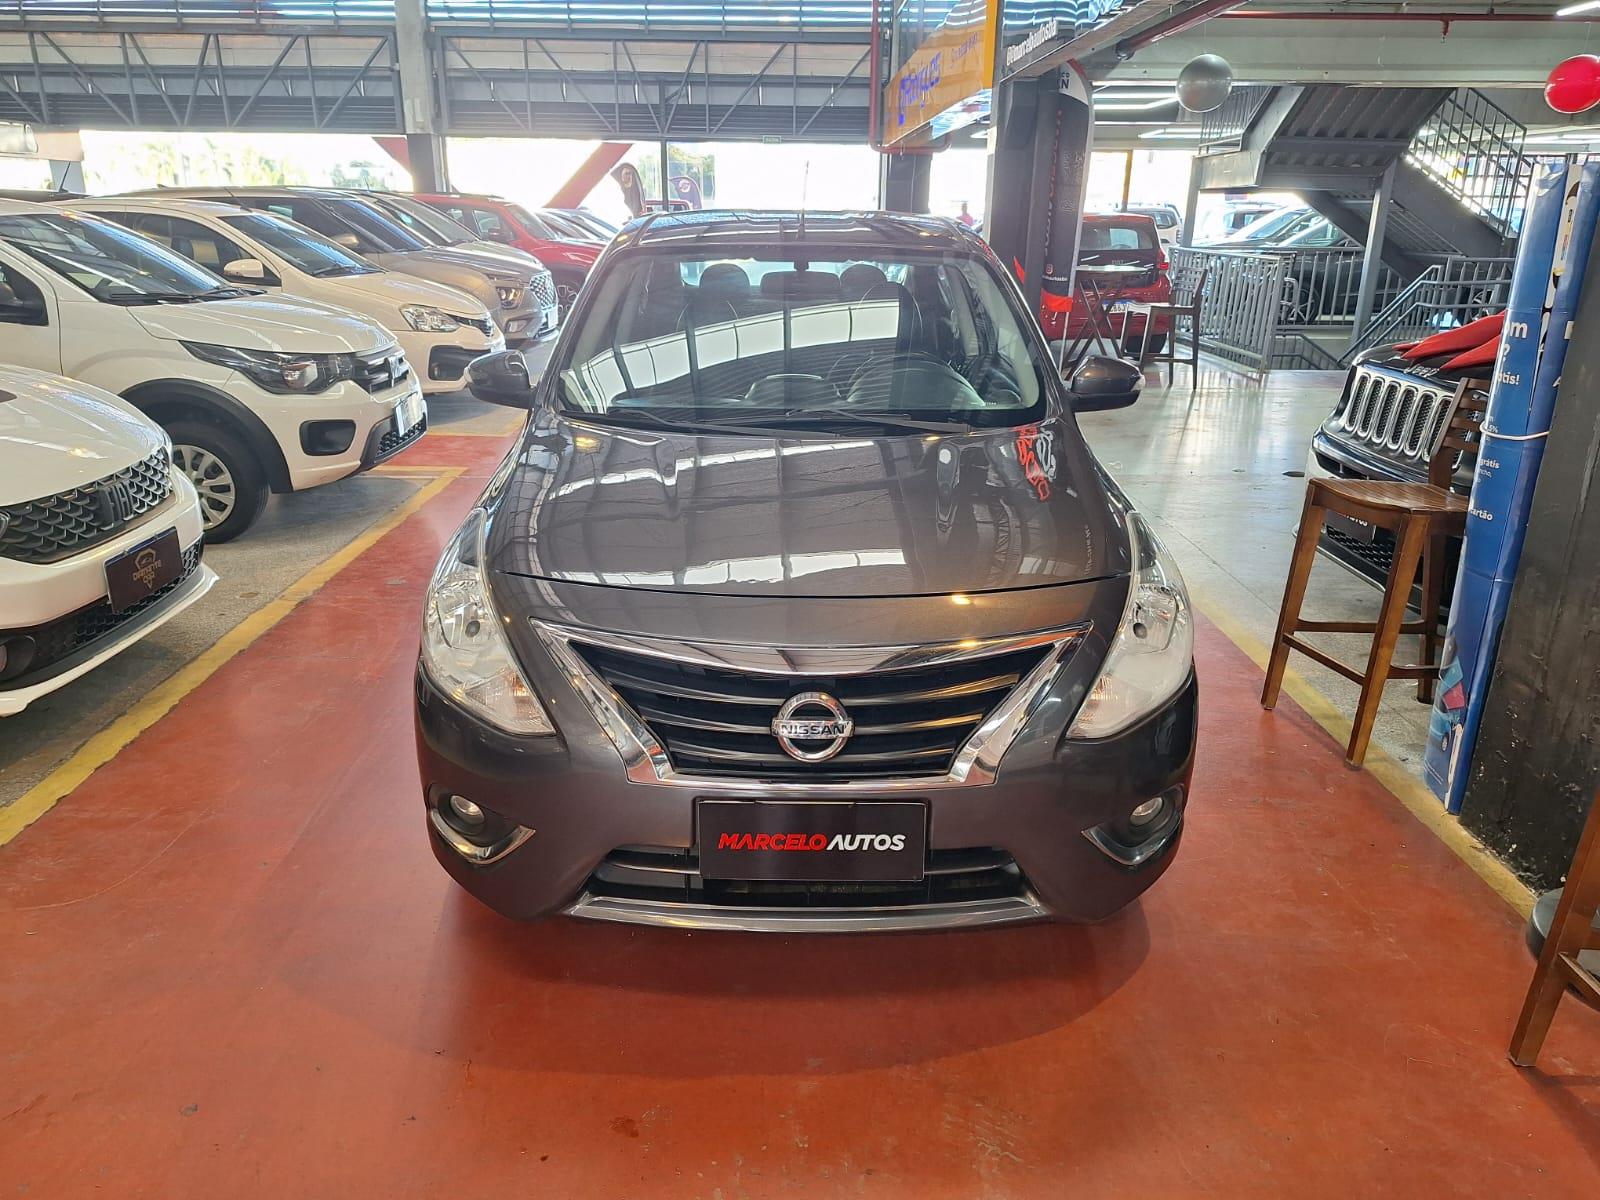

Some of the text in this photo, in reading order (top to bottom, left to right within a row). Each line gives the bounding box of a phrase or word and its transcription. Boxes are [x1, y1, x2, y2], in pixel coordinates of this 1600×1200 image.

[781, 723, 845, 736] NISSAN
[718, 833, 906, 851] MARCELO AUTOS
